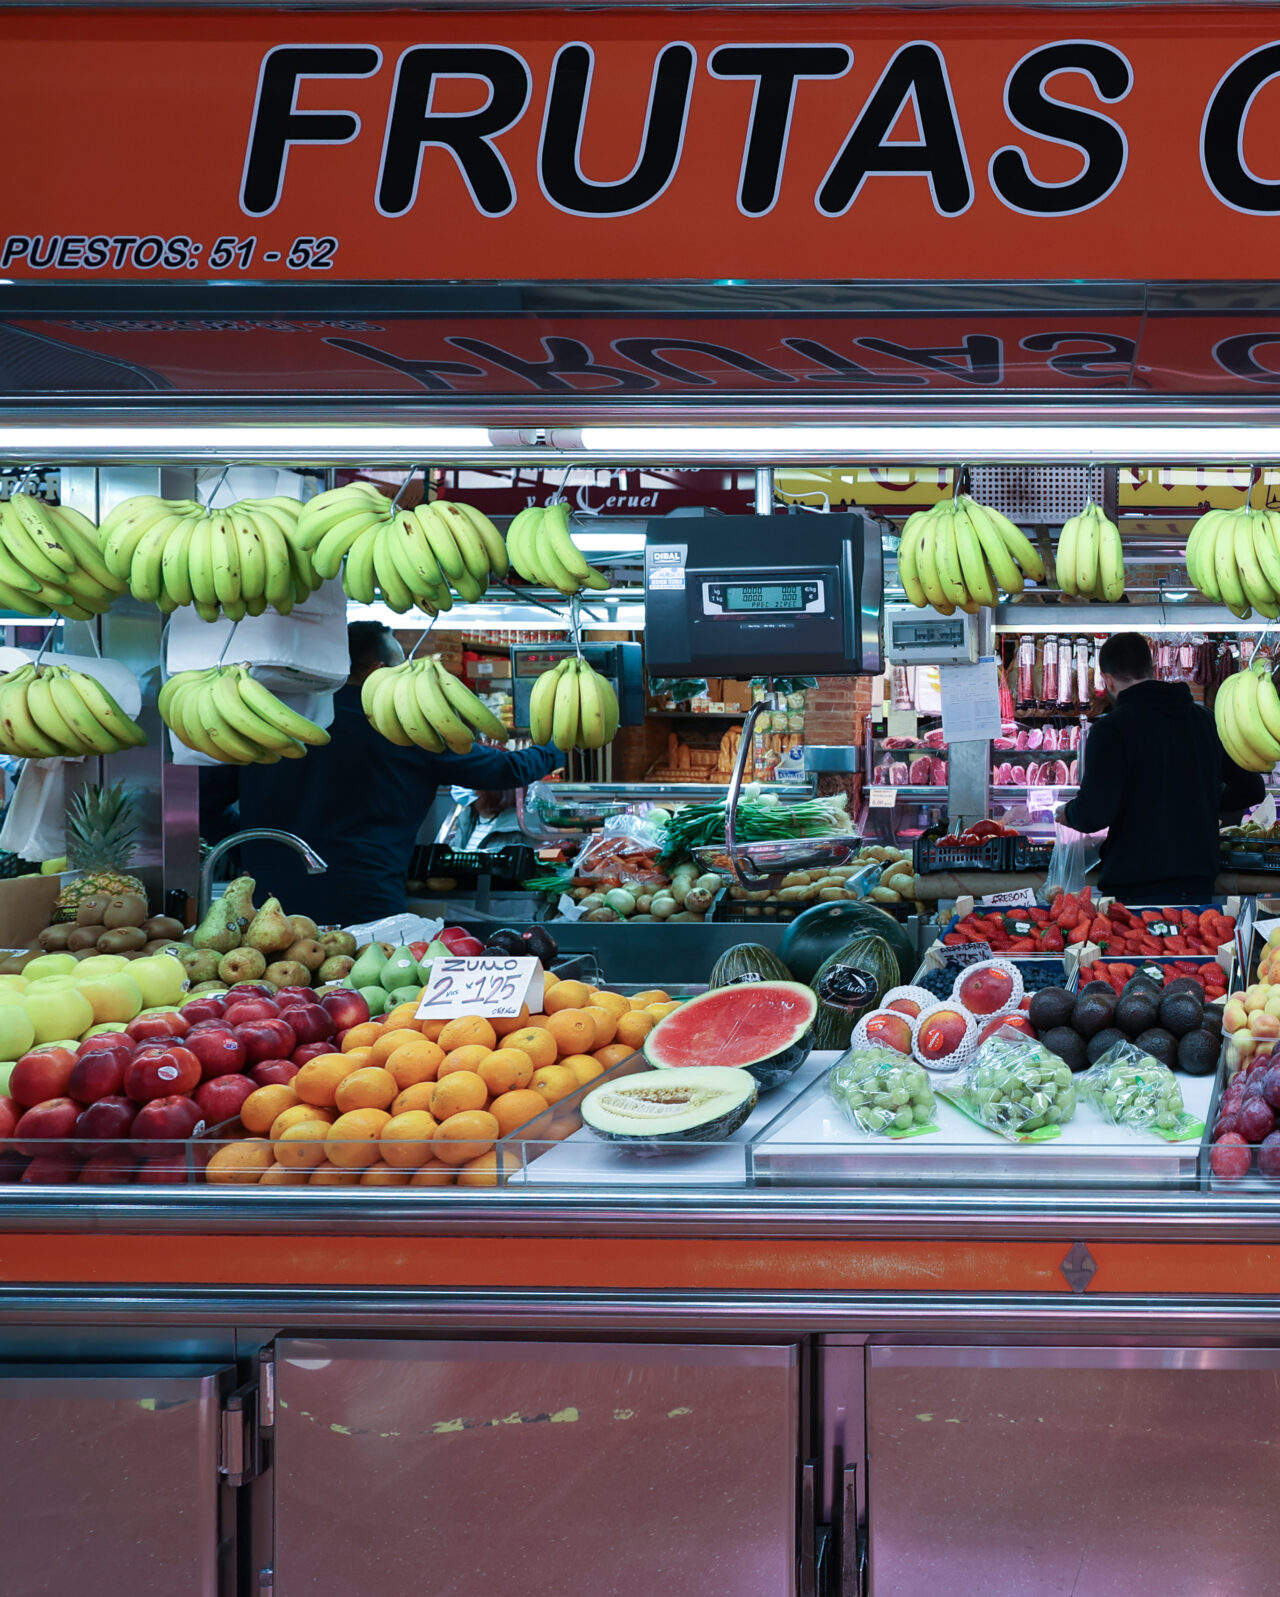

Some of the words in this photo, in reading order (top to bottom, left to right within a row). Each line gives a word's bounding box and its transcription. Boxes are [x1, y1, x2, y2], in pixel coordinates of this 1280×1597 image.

[238, 39, 1134, 219] FRUTAS
[1, 235, 203, 270] PUESTOS:
[209, 235, 256, 270] 51
[284, 236, 339, 270] 52
[654, 552, 680, 560] DIBAL
[441, 959, 518, 972] ZUMO
[424, 976, 454, 1007] 2
